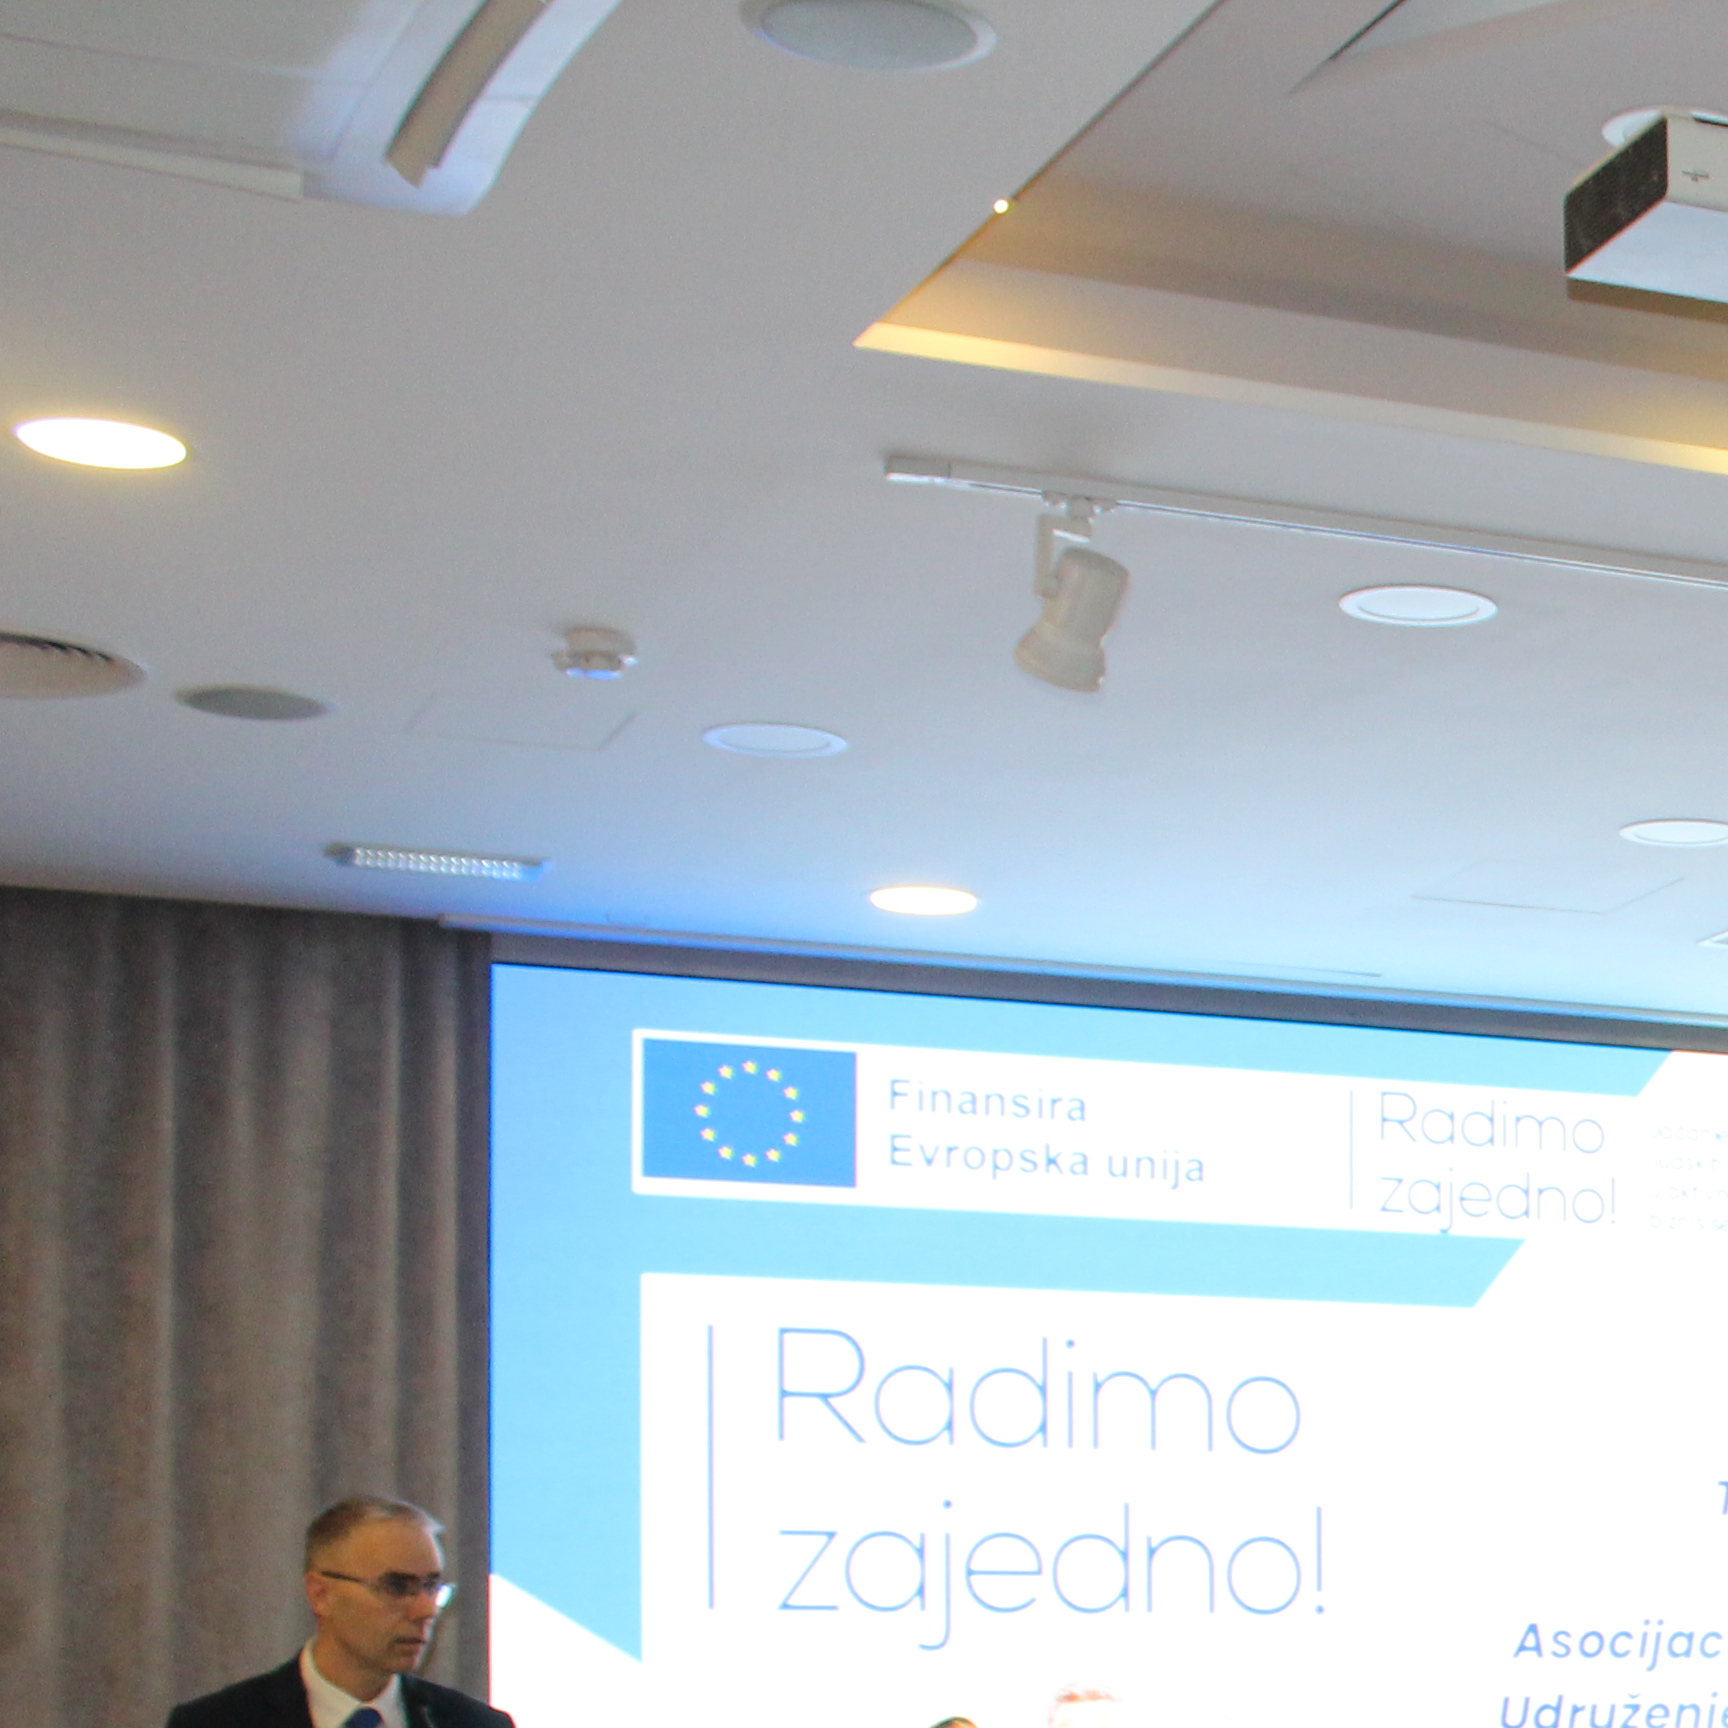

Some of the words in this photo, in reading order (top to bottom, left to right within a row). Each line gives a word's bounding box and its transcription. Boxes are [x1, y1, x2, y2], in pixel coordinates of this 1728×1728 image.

[890, 1079, 1085, 1121] Finansira
[1380, 1091, 1606, 1155] Radimo
[890, 1134, 1088, 1179] Evropska
[1108, 1146, 1205, 1191] unija
[1380, 1172, 1616, 1236] zajedno!
[778, 1327, 1300, 1455] Radimo
[777, 1499, 1324, 1651] zajedno!
